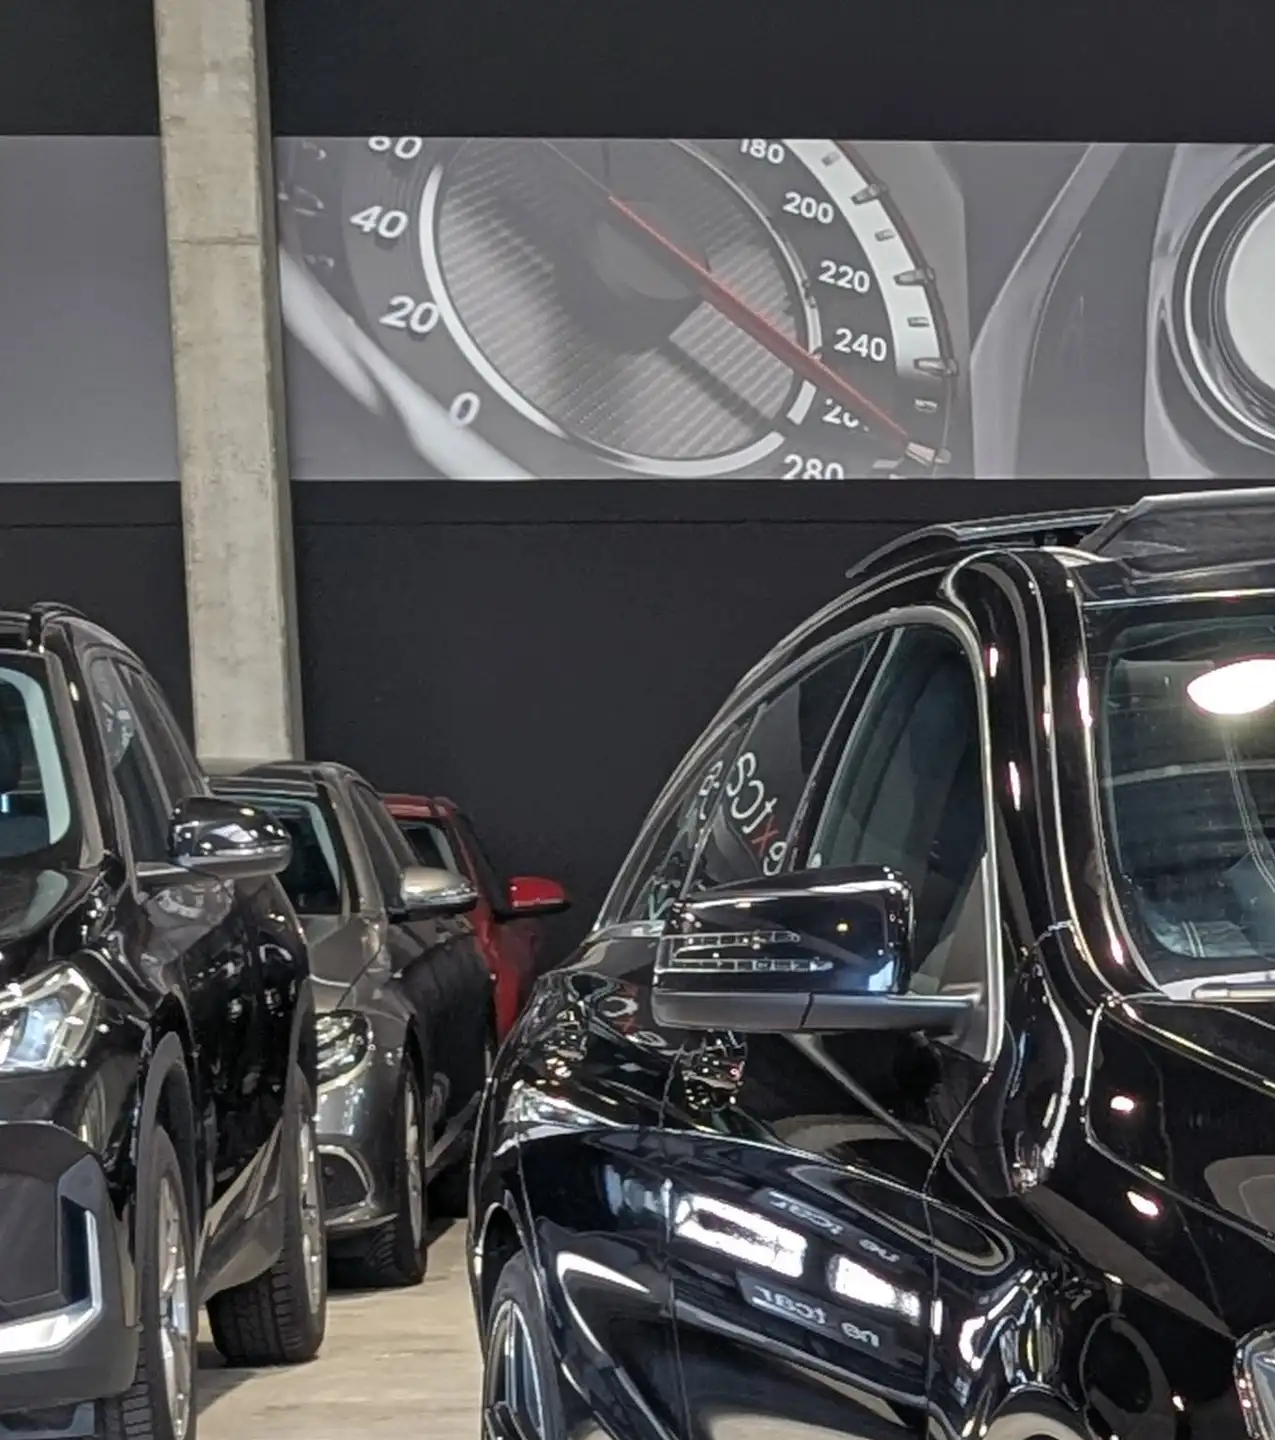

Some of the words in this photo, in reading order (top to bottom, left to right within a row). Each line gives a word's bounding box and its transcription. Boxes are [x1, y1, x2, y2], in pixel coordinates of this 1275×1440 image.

[350, 205, 409, 239] 40
[782, 191, 834, 224] 200
[818, 259, 871, 294] 220
[379, 297, 440, 334] 20
[834, 327, 887, 361] 240
[448, 392, 481, 428] 0
[782, 453, 845, 480] 280
